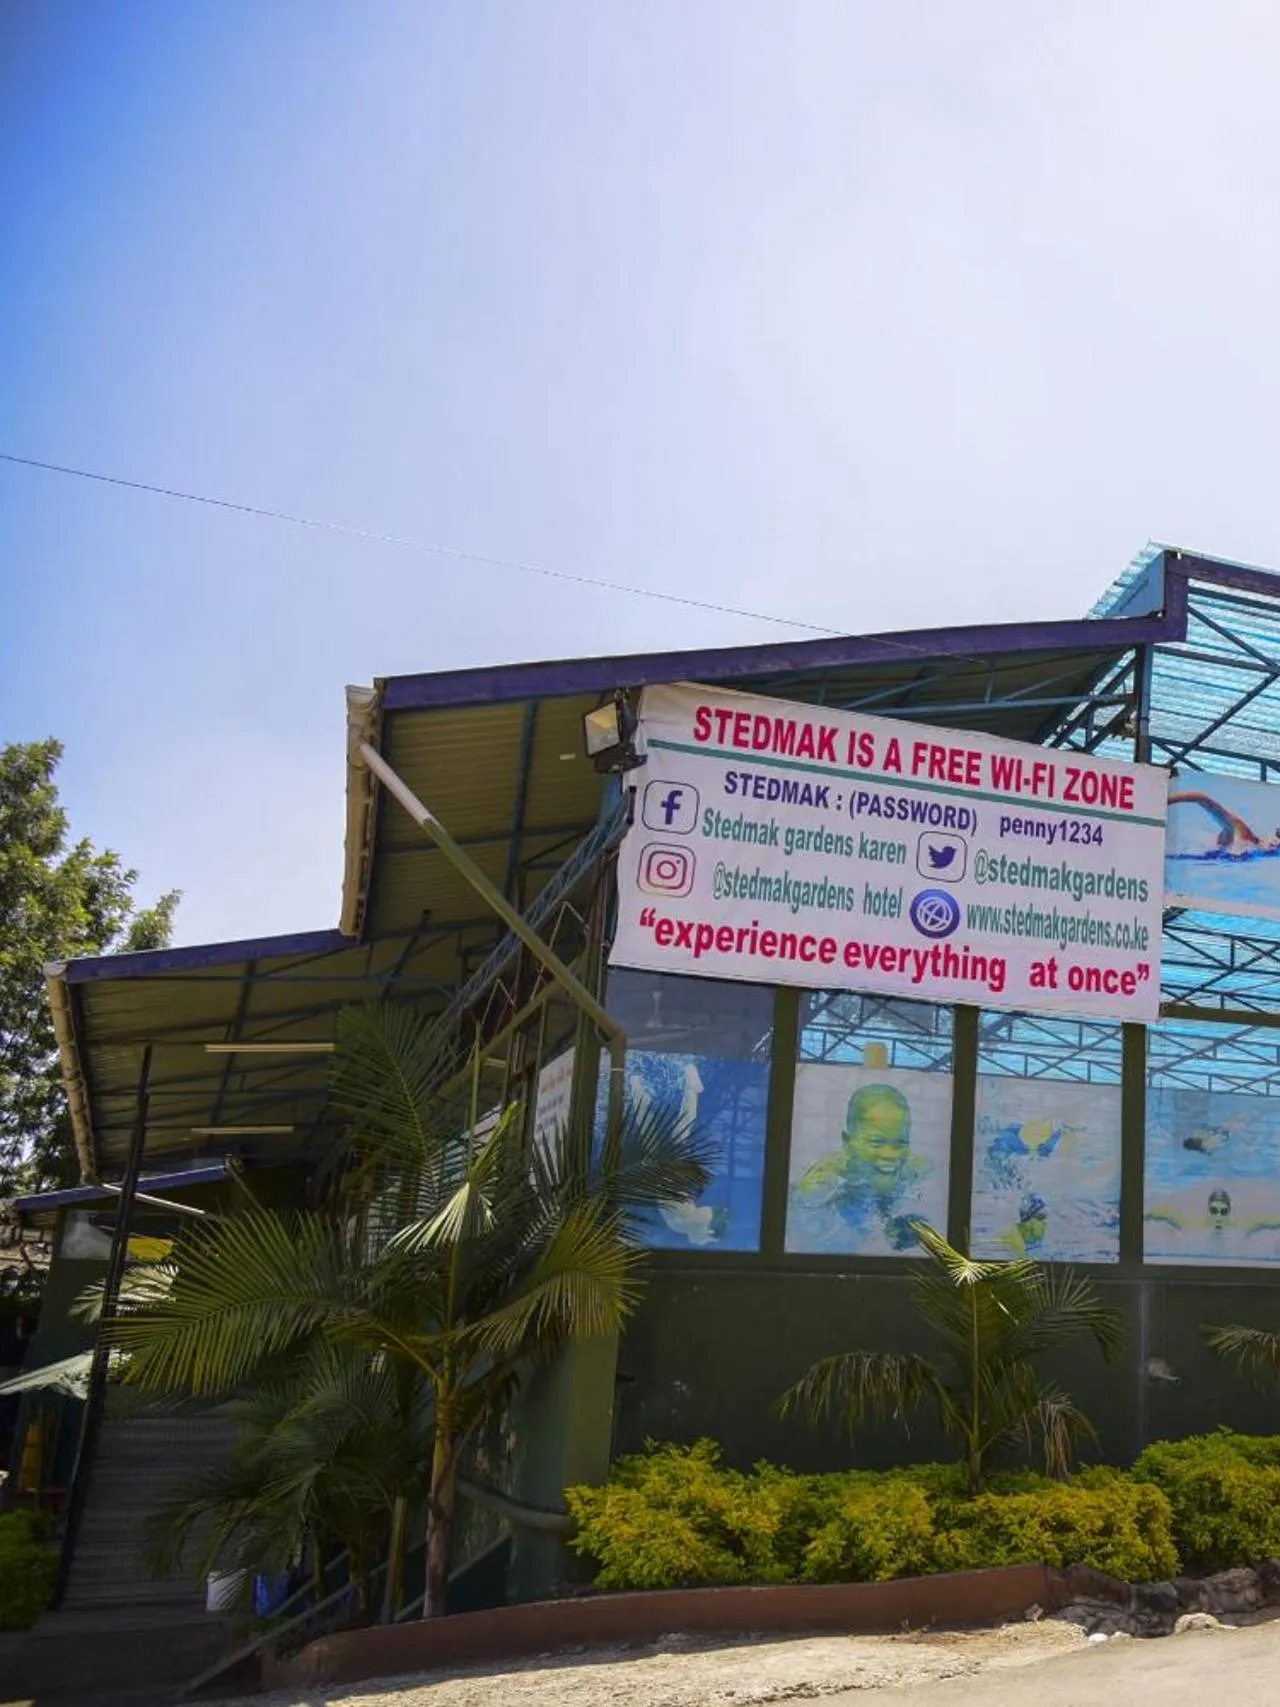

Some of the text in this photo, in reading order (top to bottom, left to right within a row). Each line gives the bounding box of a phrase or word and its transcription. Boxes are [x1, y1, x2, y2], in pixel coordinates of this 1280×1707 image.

[693, 706, 1135, 810] STEDMAK IS A FREE WI-FI ZONE
[703, 807, 906, 864] Stedmak gardens karen
[724, 771, 831, 809] STEDMAK
[849, 791, 977, 836] (PASSWORD)
[1000, 815, 1103, 846] penny1234
[713, 862, 903, 919] @stedmakgardens hotel
[974, 849, 1149, 901] @stedmakgardens
[967, 902, 1149, 951] www.stedmakgardens.co.ke
[843, 941, 1006, 993] everything
[1030, 957, 1057, 989] at
